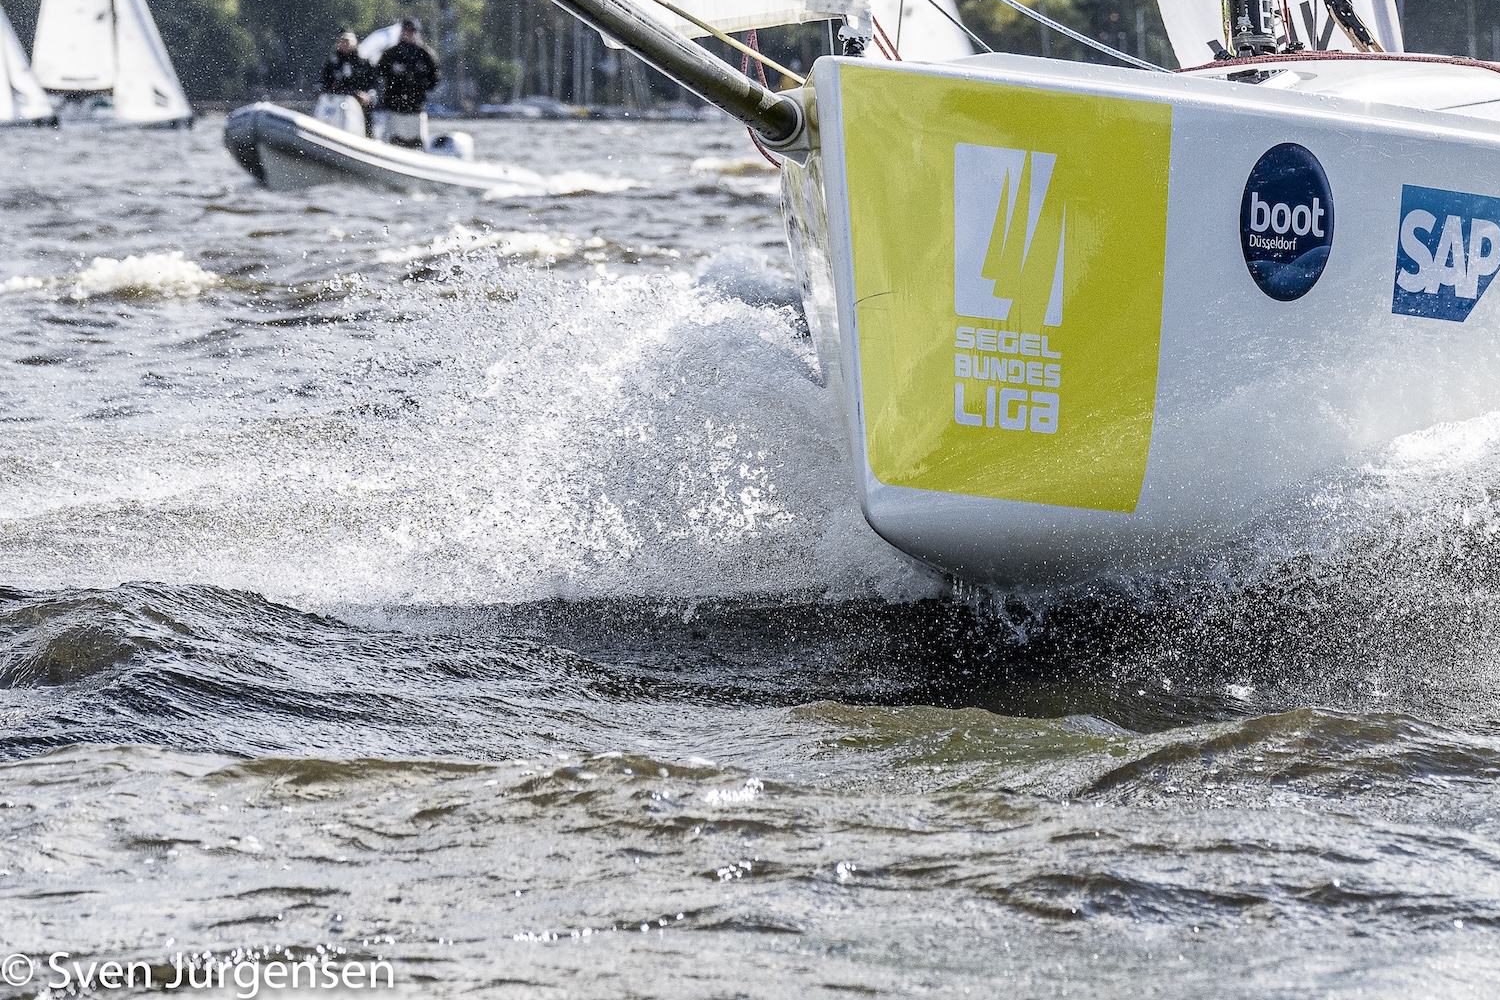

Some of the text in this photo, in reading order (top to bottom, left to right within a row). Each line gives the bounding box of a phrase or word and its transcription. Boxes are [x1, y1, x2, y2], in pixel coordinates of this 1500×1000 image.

[1250, 191, 1325, 238] boot
[1249, 233, 1297, 251] Düsseldorf
[954, 325, 1062, 359] SEGEL
[954, 353, 1061, 388] BUNDES
